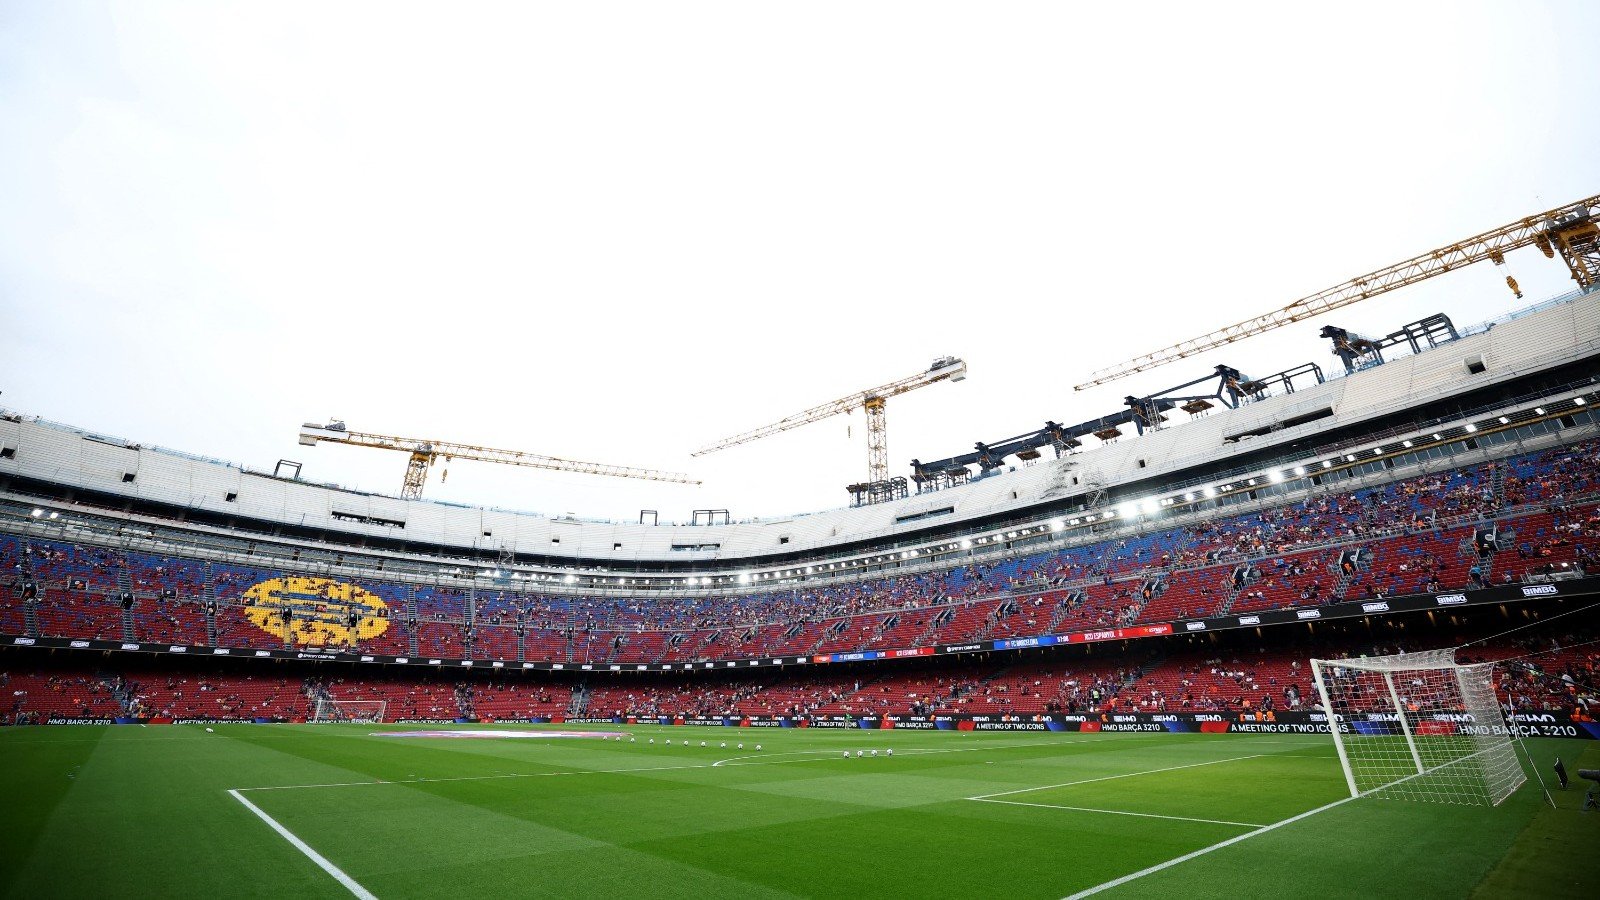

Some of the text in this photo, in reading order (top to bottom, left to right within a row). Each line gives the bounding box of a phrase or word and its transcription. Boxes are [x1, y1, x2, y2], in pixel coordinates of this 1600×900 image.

[1522, 586, 1558, 597] BIMBO
[1436, 595, 1467, 605] BIMBO
[1362, 603, 1389, 613] BIMBO
[1297, 610, 1321, 619] BIMBO
[1094, 631, 1115, 639] ESPANYOL
[1017, 638, 1038, 646] BARCELONA
[1119, 724, 1142, 733] BARÇA
[1231, 724, 1238, 732] A
[1238, 724, 1277, 732] MEETING
[1278, 724, 1290, 732] OF
[1291, 724, 1314, 733] TWO
[1459, 726, 1489, 735] HMD
